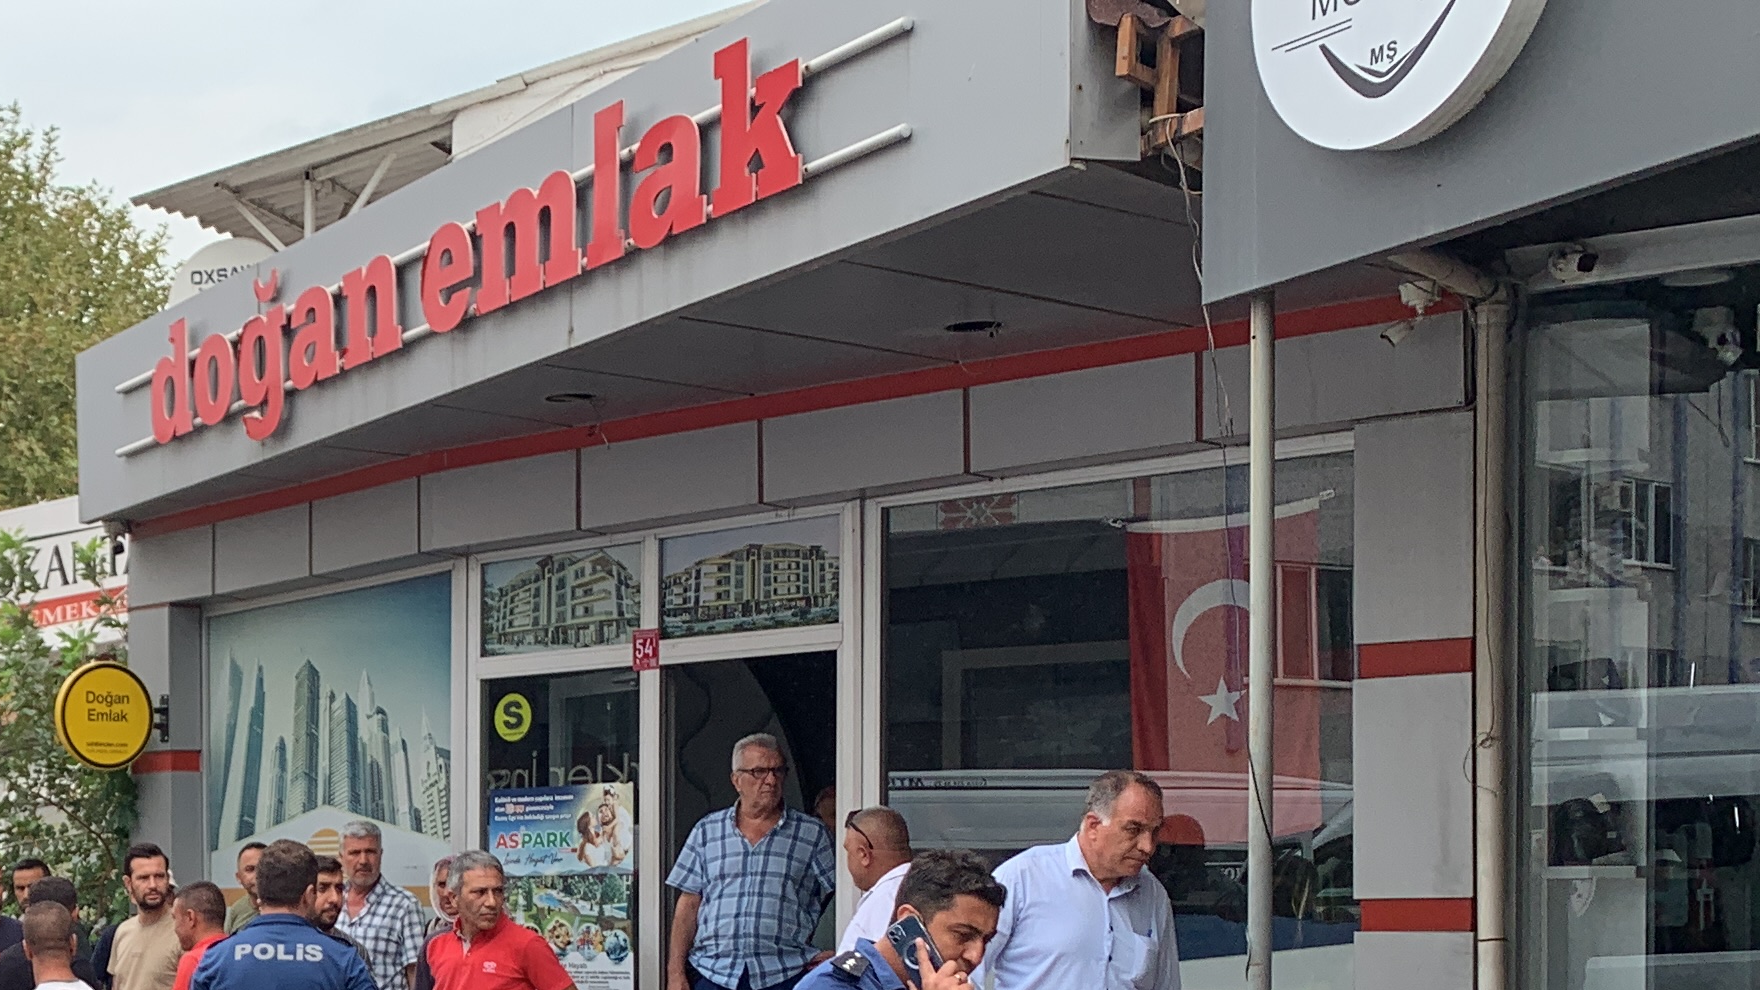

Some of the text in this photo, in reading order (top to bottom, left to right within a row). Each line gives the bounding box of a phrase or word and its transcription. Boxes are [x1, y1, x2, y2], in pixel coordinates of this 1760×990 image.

[1369, 40, 1398, 66] MŞ
[151, 36, 803, 445] doğan emlak
[85, 690, 130, 708] Doğan
[87, 708, 129, 723] Emlak
[495, 831, 572, 849] ASPARK
